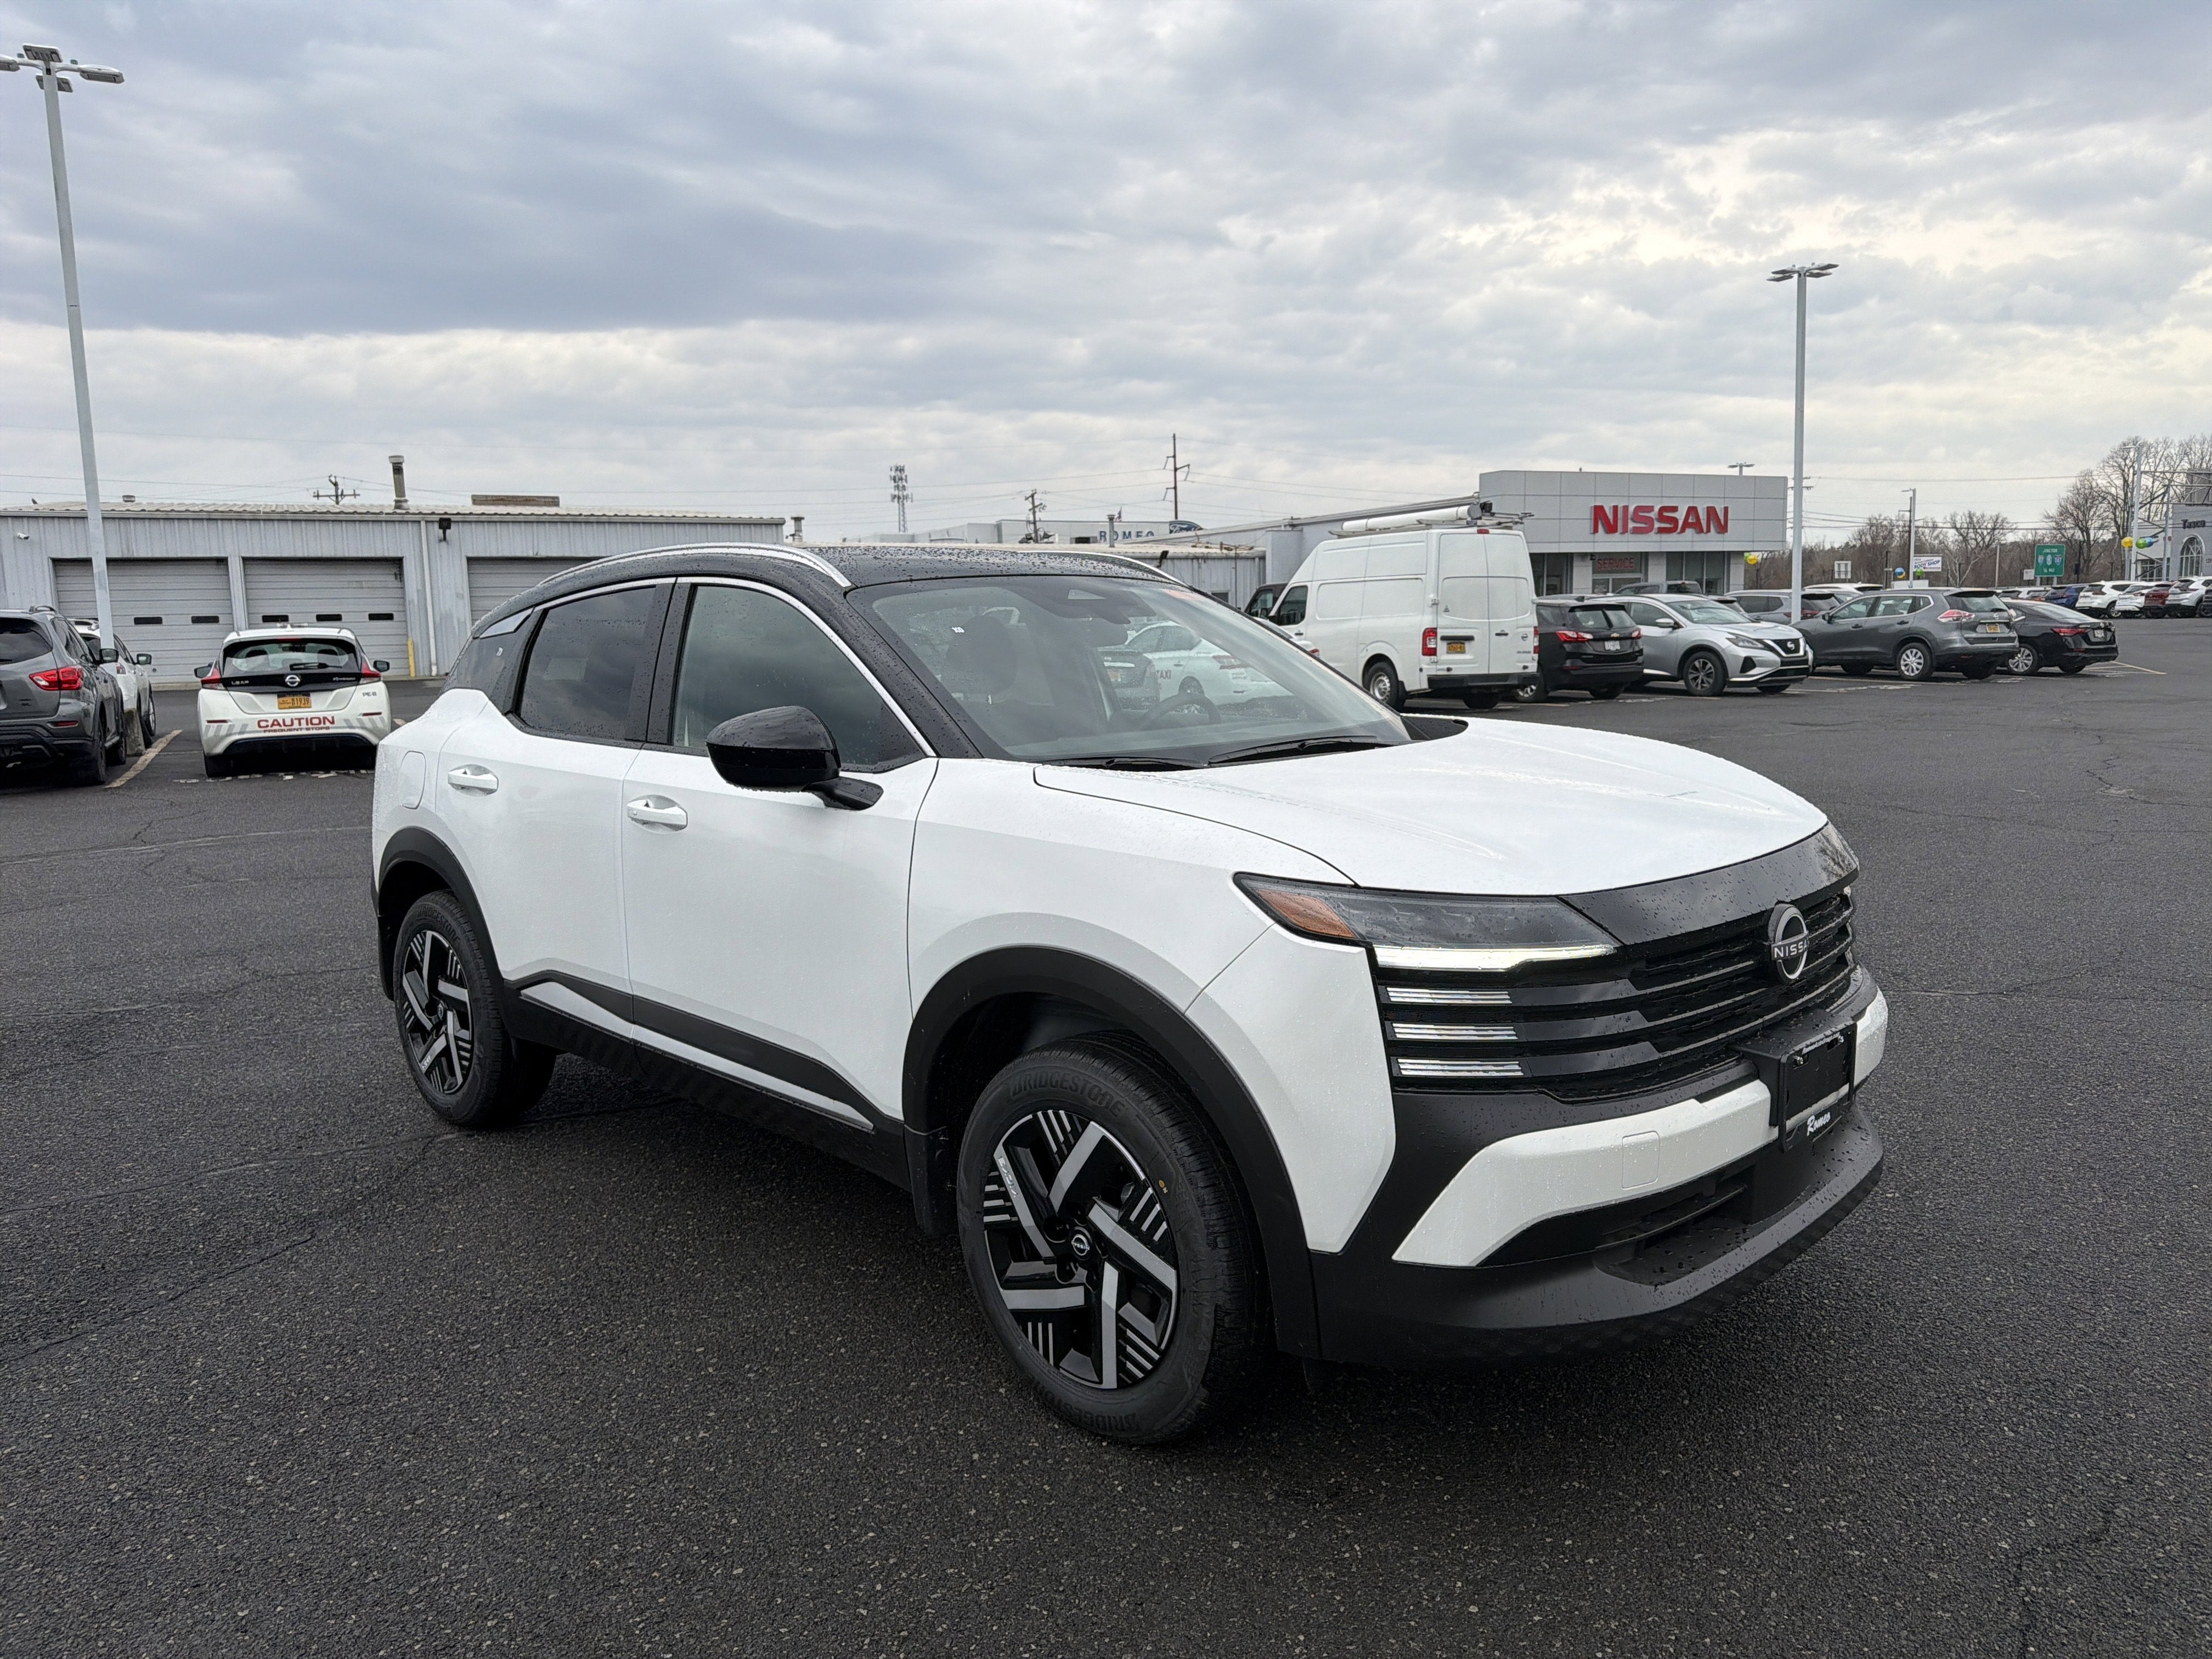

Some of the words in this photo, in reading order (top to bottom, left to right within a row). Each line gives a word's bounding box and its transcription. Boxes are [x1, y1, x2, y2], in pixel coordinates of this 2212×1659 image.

[1592, 505, 1729, 534] NISSAN
[1597, 557, 1634, 569] SERVICE
[257, 715, 336, 729] CAUTION
[1011, 1070, 1128, 1118] BRIDGESTONE
